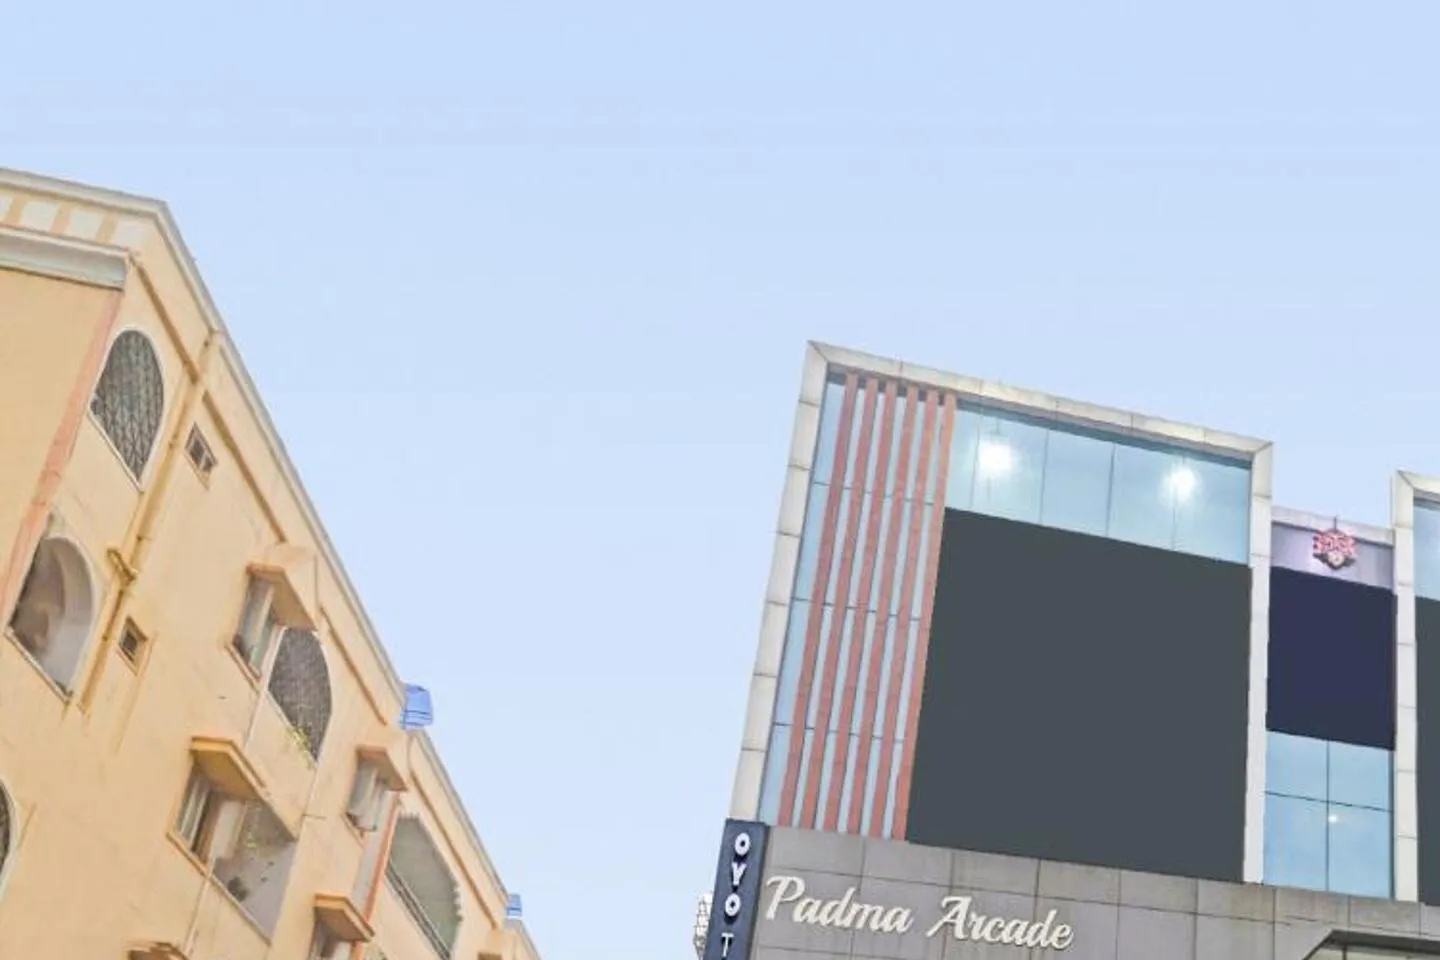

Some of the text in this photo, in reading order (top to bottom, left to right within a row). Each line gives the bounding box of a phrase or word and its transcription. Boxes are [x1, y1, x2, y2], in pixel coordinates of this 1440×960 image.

[724, 831, 752, 919] OYO
[766, 875, 1074, 949] Padma Arcade
